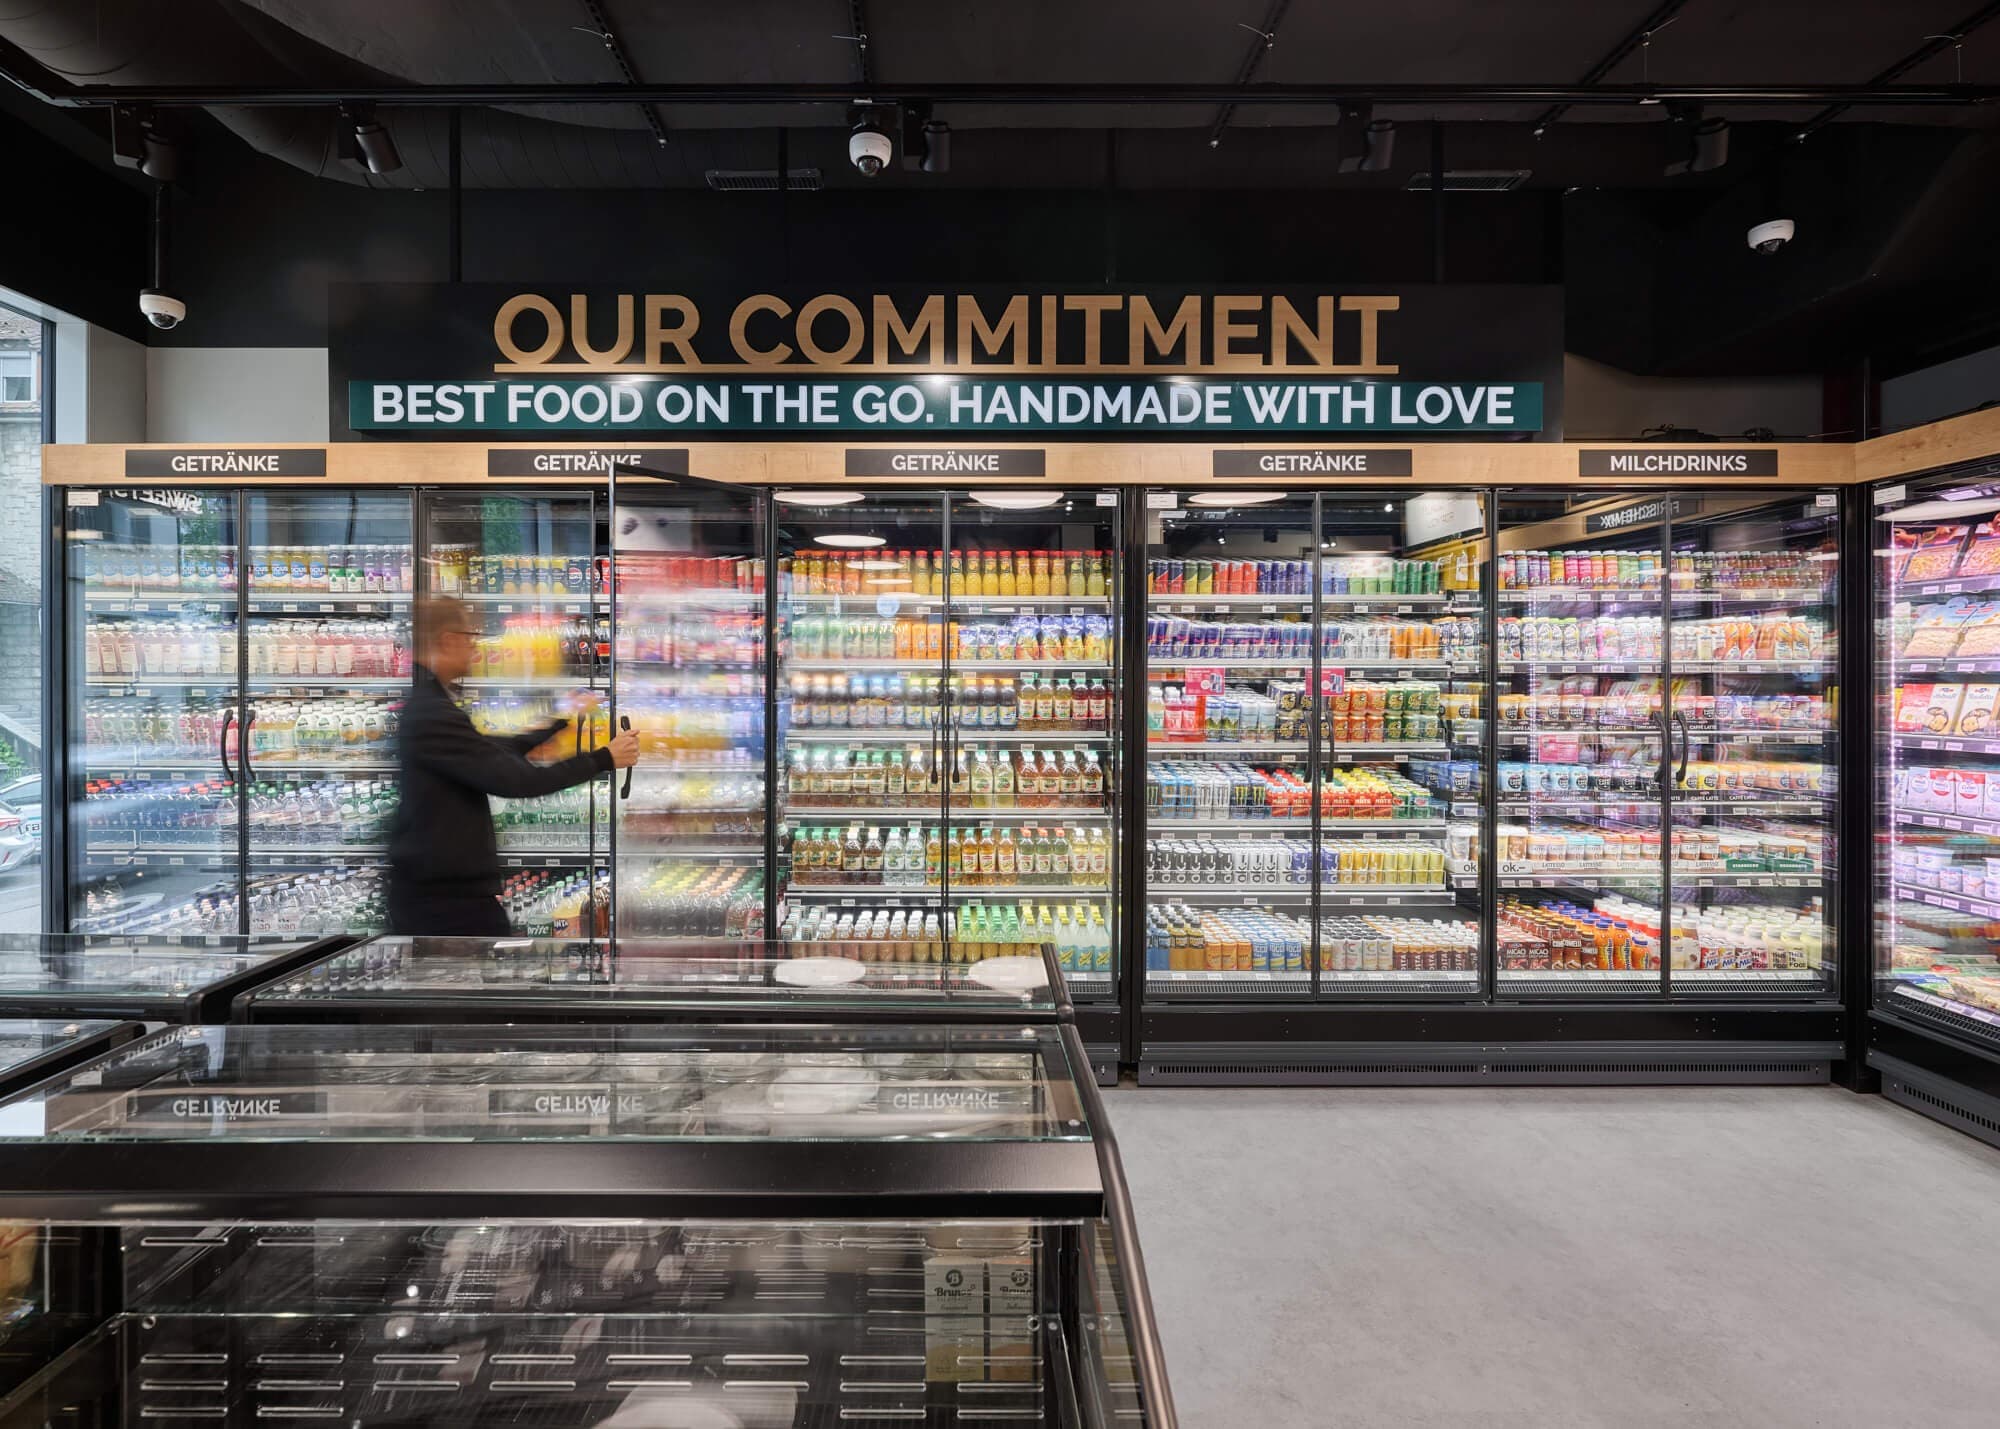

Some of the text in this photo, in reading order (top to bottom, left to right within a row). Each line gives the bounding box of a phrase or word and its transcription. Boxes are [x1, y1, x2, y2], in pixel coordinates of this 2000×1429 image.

[494, 293, 1400, 369] OUR COMMITMENT
[372, 384, 1514, 425] BEST FOOD ON THE GO. HANDMADE WITH LOVE
[171, 451, 280, 472] GETRÄNKE
[891, 450, 1000, 471] GETRÄNKE
[1259, 451, 1367, 471] GETRÄNKE
[1610, 455, 1748, 472] MILCHDRINKS
